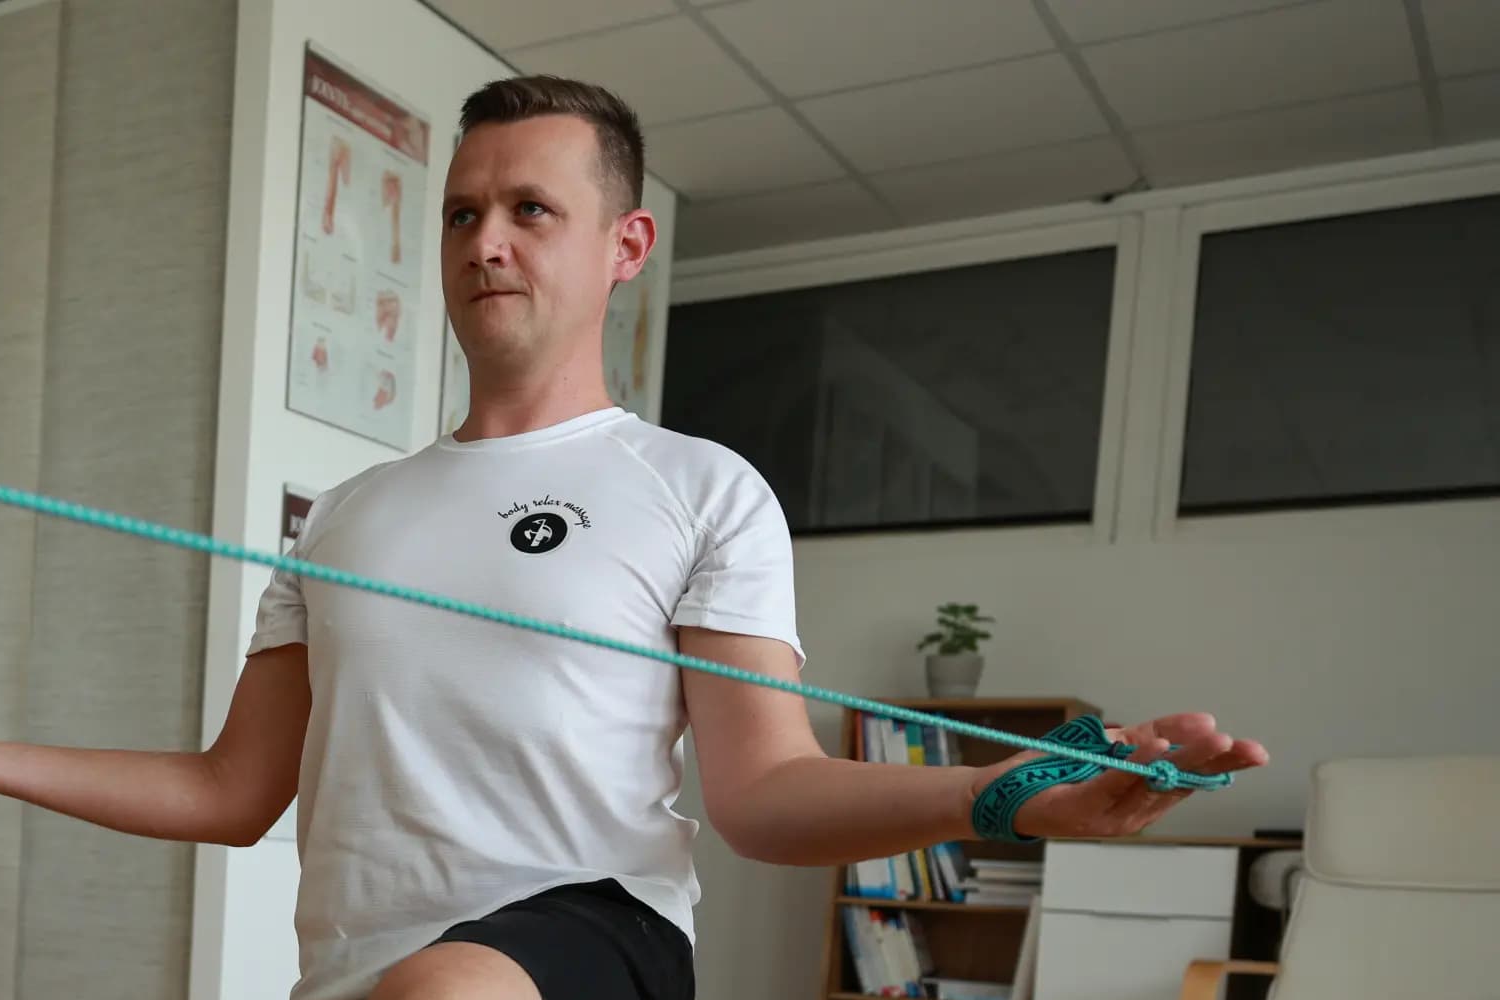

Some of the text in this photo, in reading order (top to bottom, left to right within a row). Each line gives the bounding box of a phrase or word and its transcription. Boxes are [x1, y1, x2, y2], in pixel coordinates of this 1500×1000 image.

[497, 494, 592, 530] body relax massage
